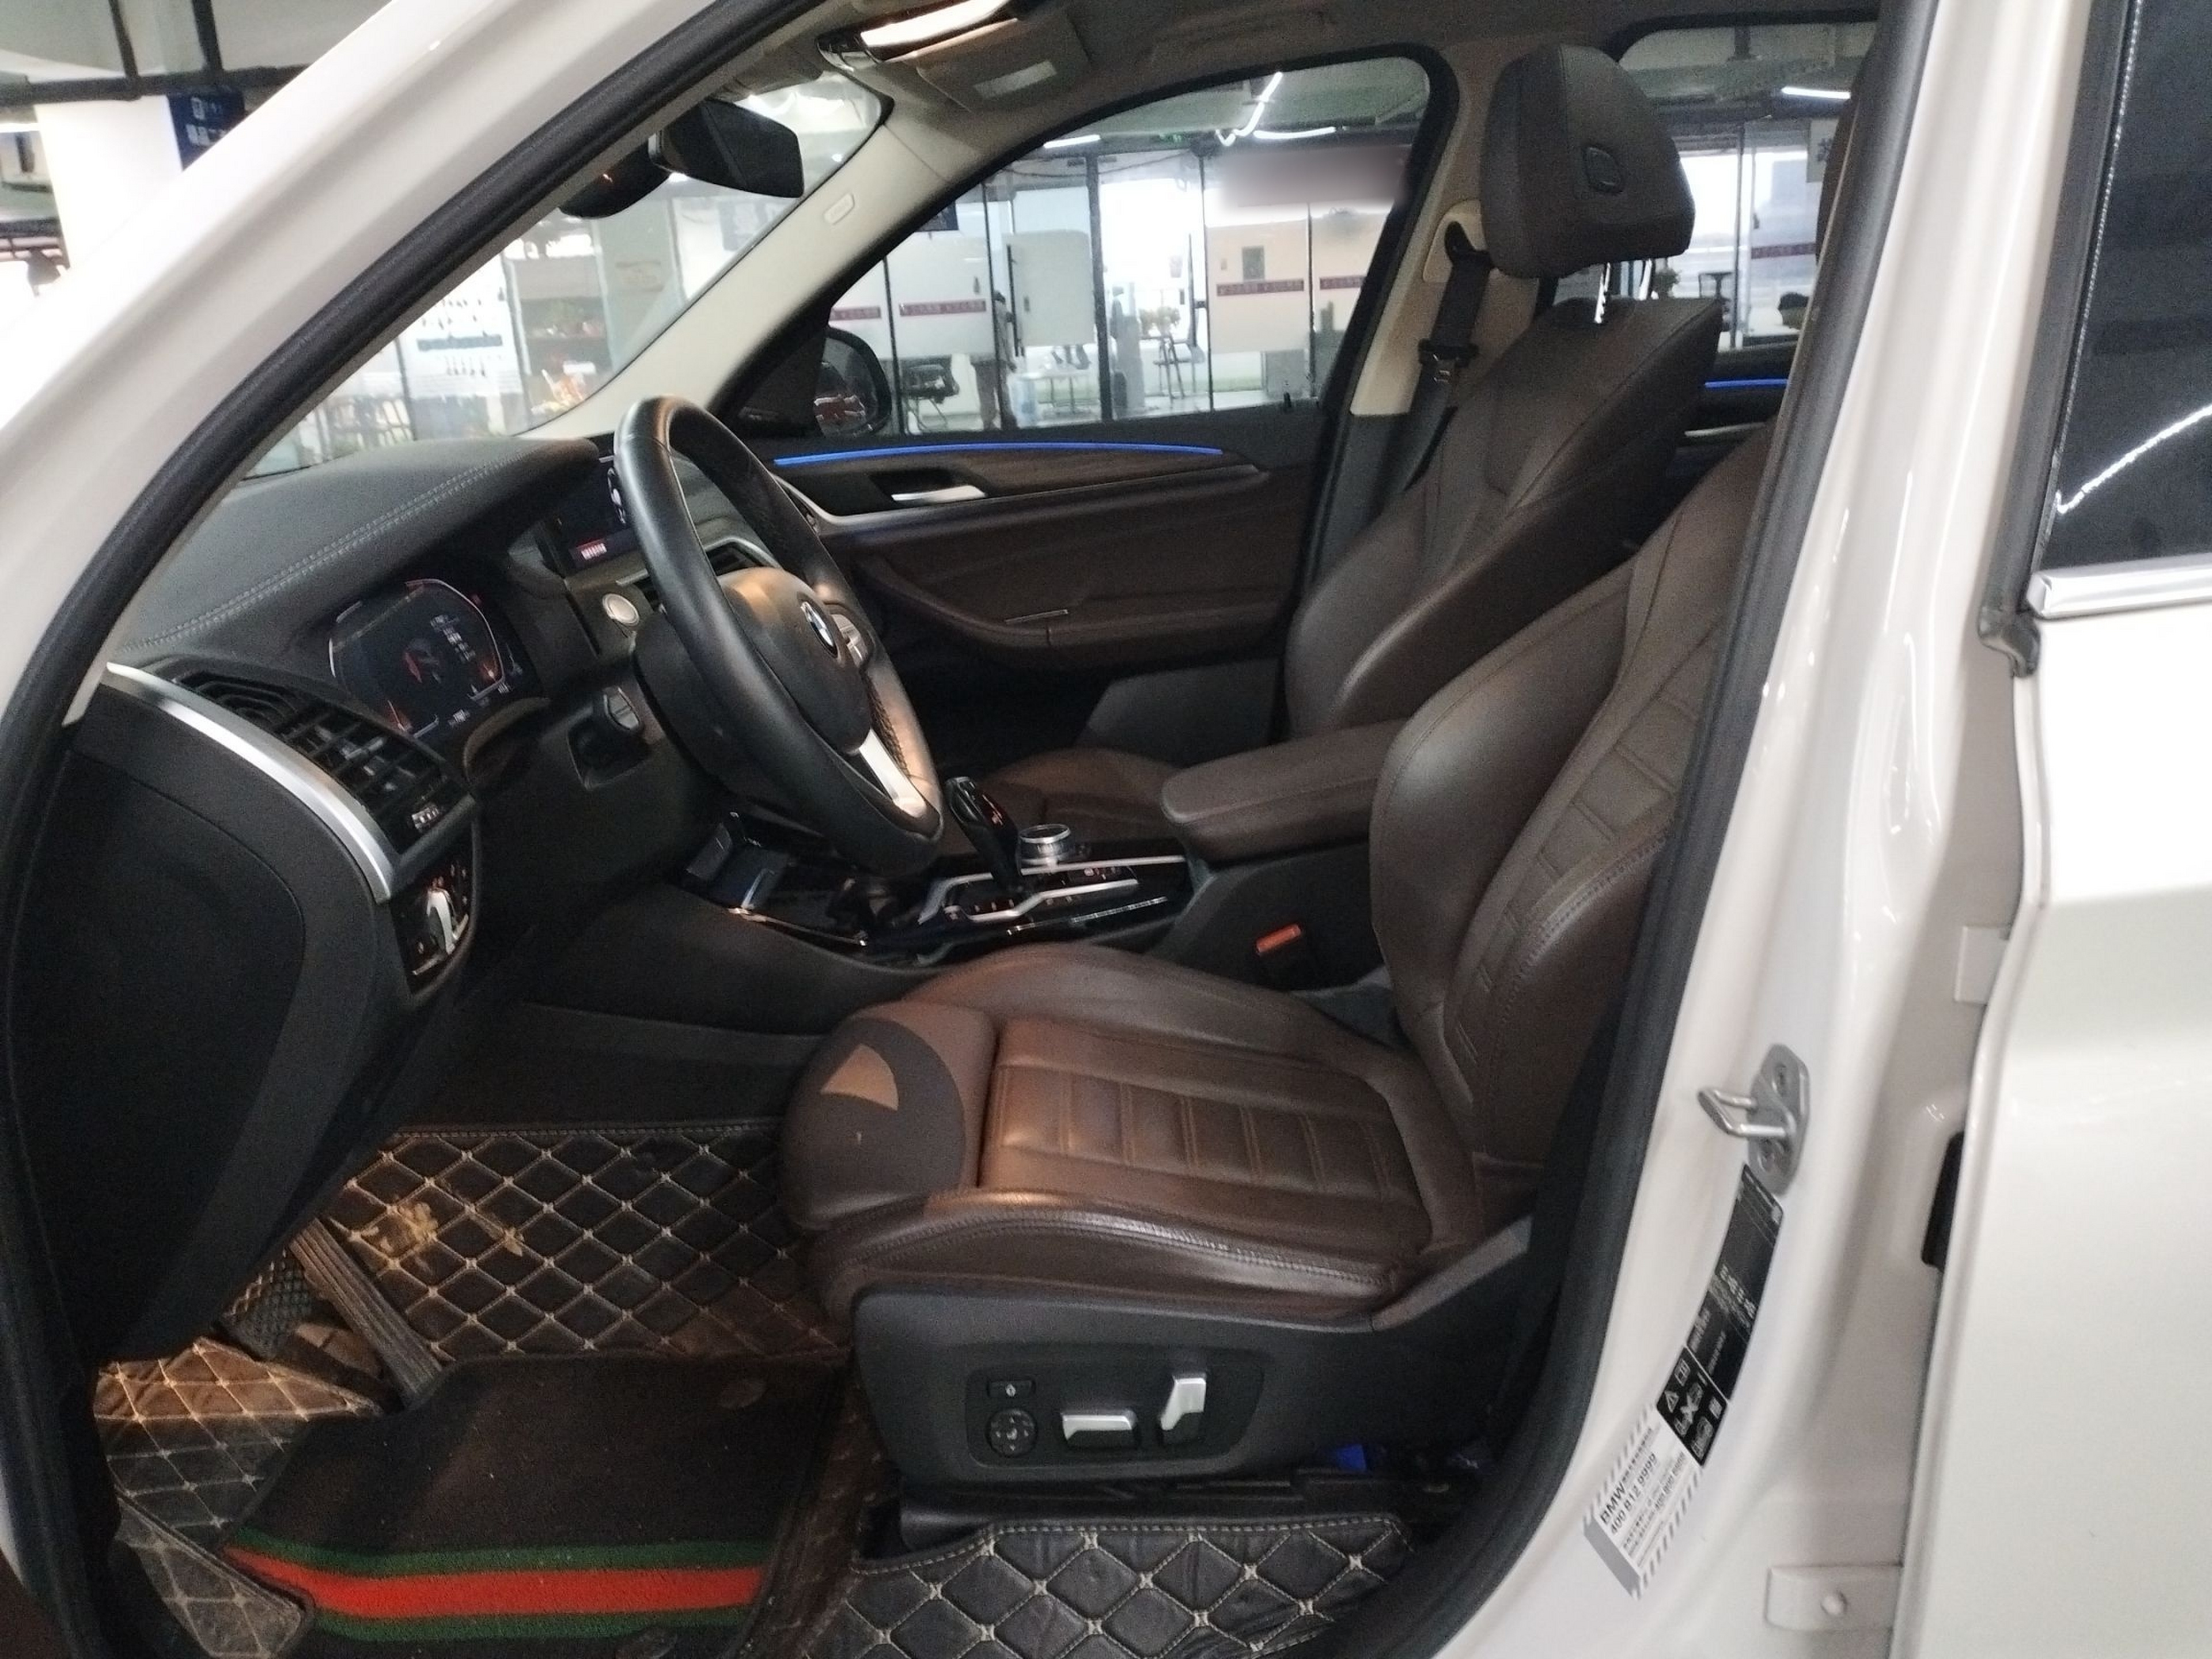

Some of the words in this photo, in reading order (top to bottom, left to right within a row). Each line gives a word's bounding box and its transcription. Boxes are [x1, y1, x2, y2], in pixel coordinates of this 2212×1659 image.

[1600, 1482, 1626, 1525] BMW
[1611, 1510, 1626, 1533] 400
[1624, 1485, 1641, 1512] 812
